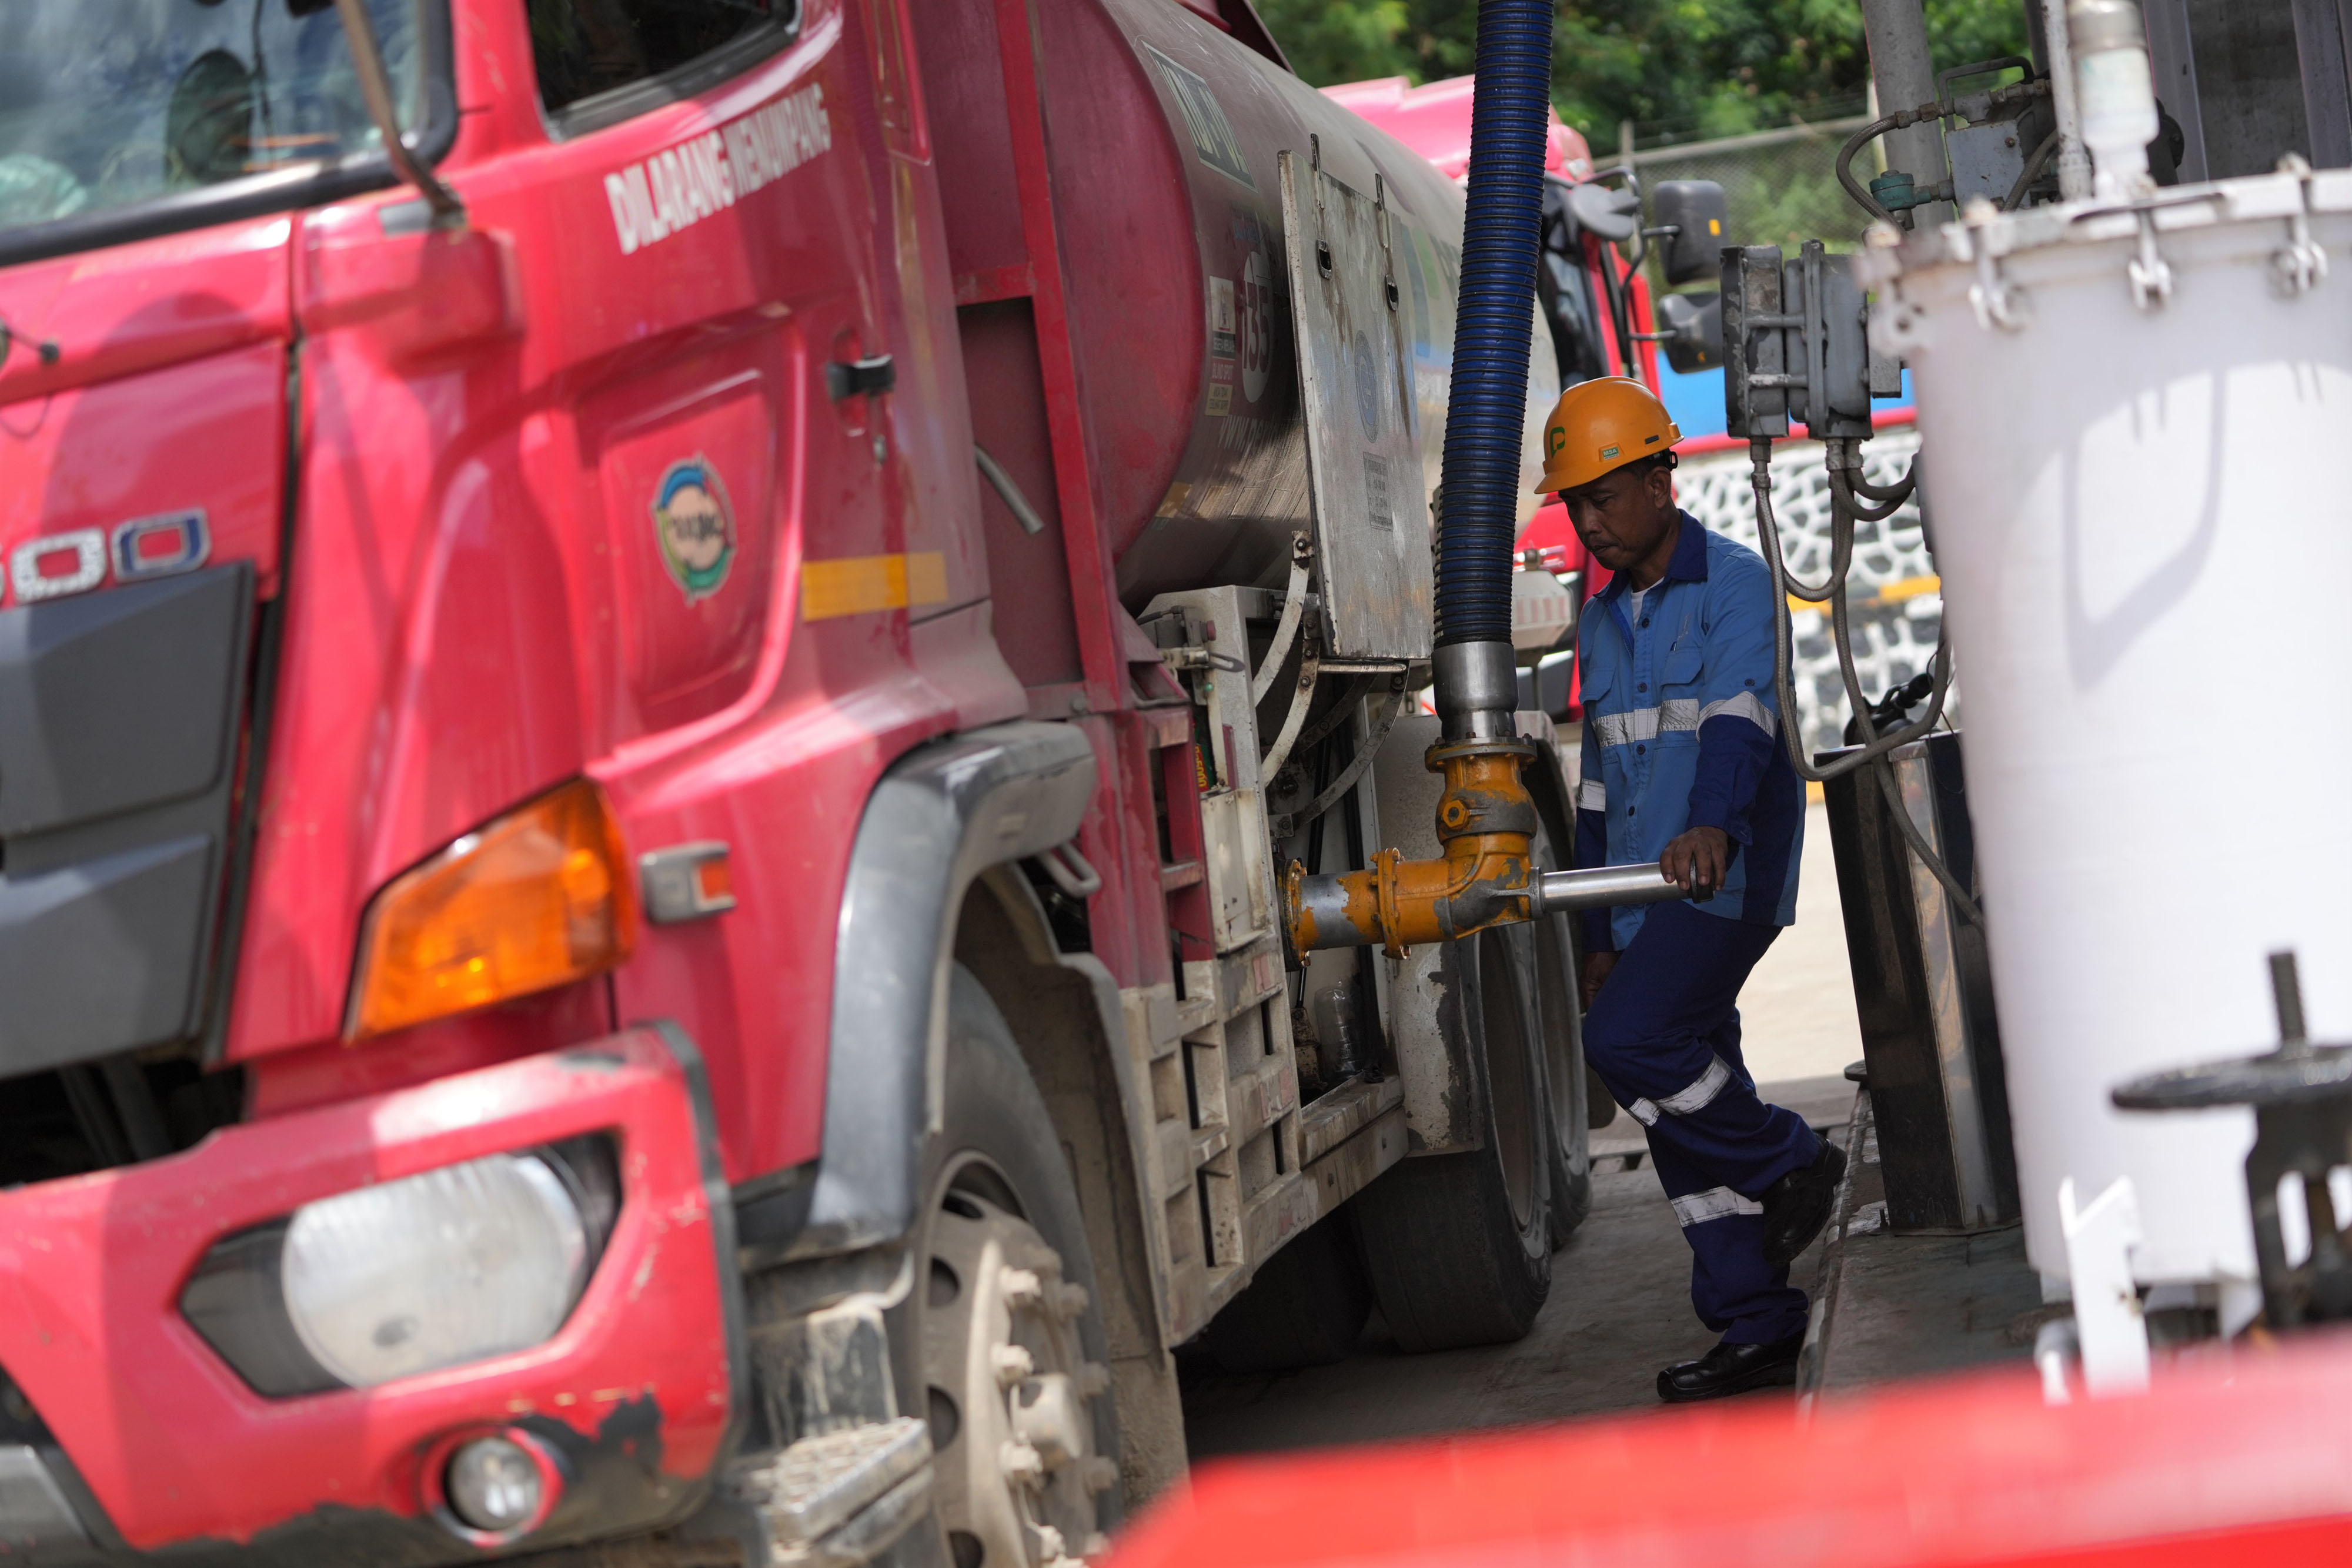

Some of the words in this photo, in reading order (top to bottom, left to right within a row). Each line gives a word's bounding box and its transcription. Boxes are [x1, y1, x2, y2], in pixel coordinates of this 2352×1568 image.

[603, 129, 735, 255] DILARANG
[722, 82, 831, 199] MENUMPANG
[1243, 282, 1269, 373] 135
[0, 507, 212, 604] 00
